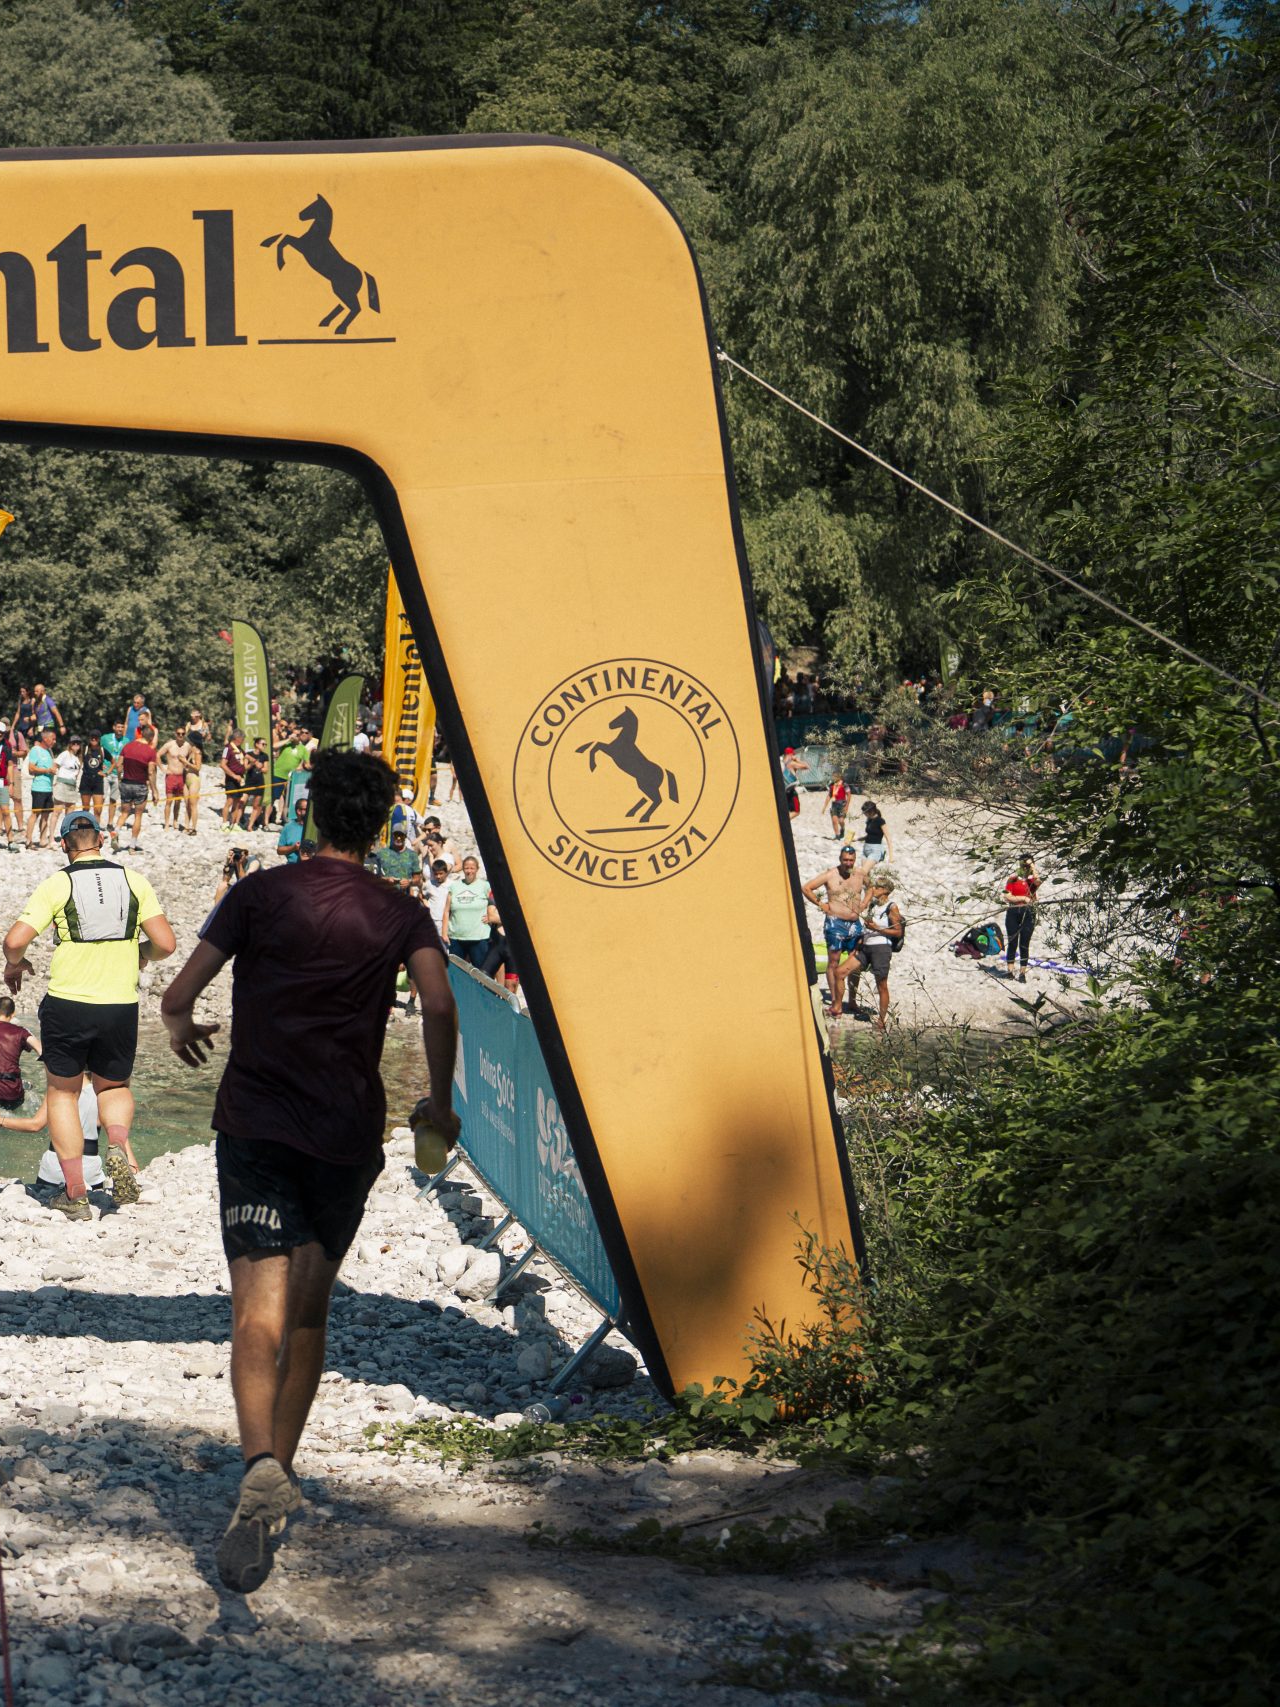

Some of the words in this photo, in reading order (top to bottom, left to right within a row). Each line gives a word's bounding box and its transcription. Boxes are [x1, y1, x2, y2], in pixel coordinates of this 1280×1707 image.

[531, 666, 722, 747] CONTINENTAL
[547, 834, 639, 881] SINCE
[647, 825, 708, 875] 1871
[95, 873, 105, 905] MAMMUT
